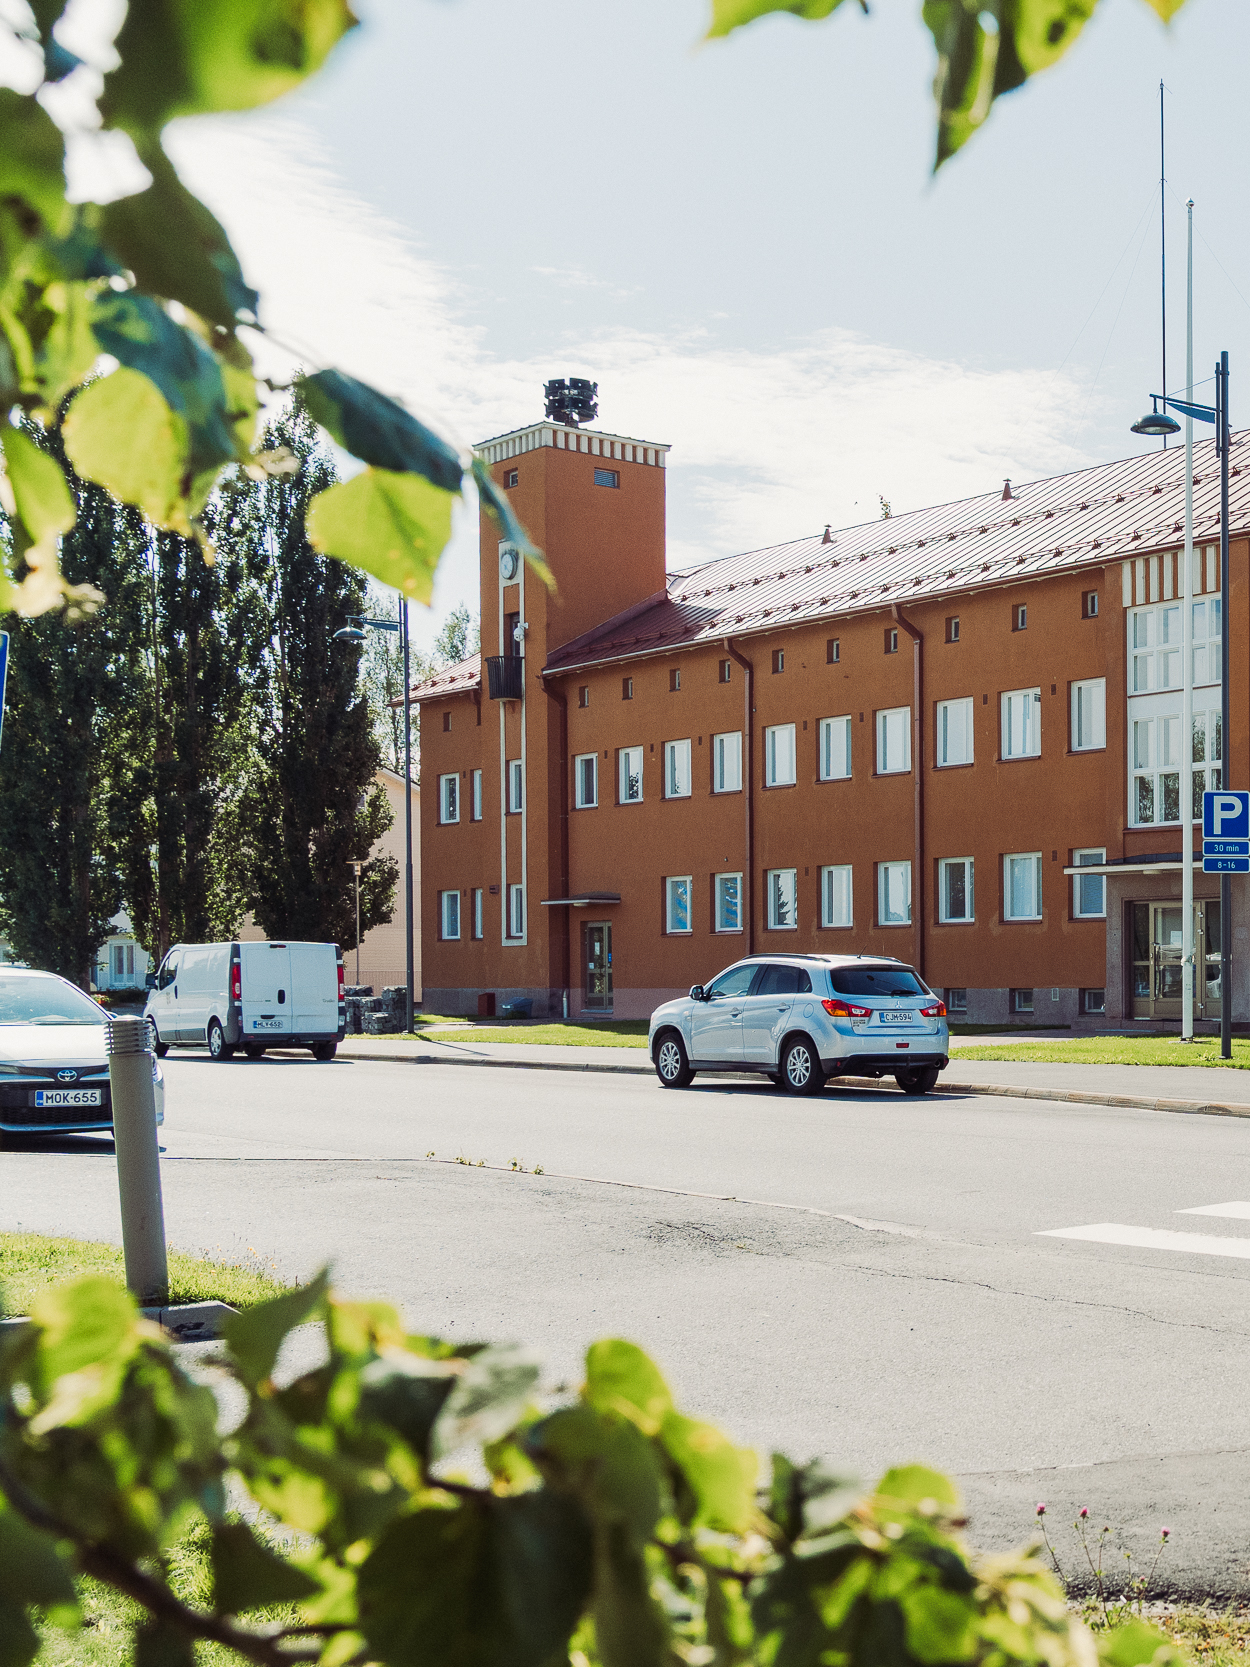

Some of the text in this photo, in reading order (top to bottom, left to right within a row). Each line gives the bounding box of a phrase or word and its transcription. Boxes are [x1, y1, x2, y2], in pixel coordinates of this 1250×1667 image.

[1213, 795, 1243, 835] P
[1214, 844, 1240, 852] 30 min
[1217, 861, 1236, 869] 8-16
[885, 1013, 912, 1021] CJM-594
[45, 1092, 98, 1104] MOK-655
